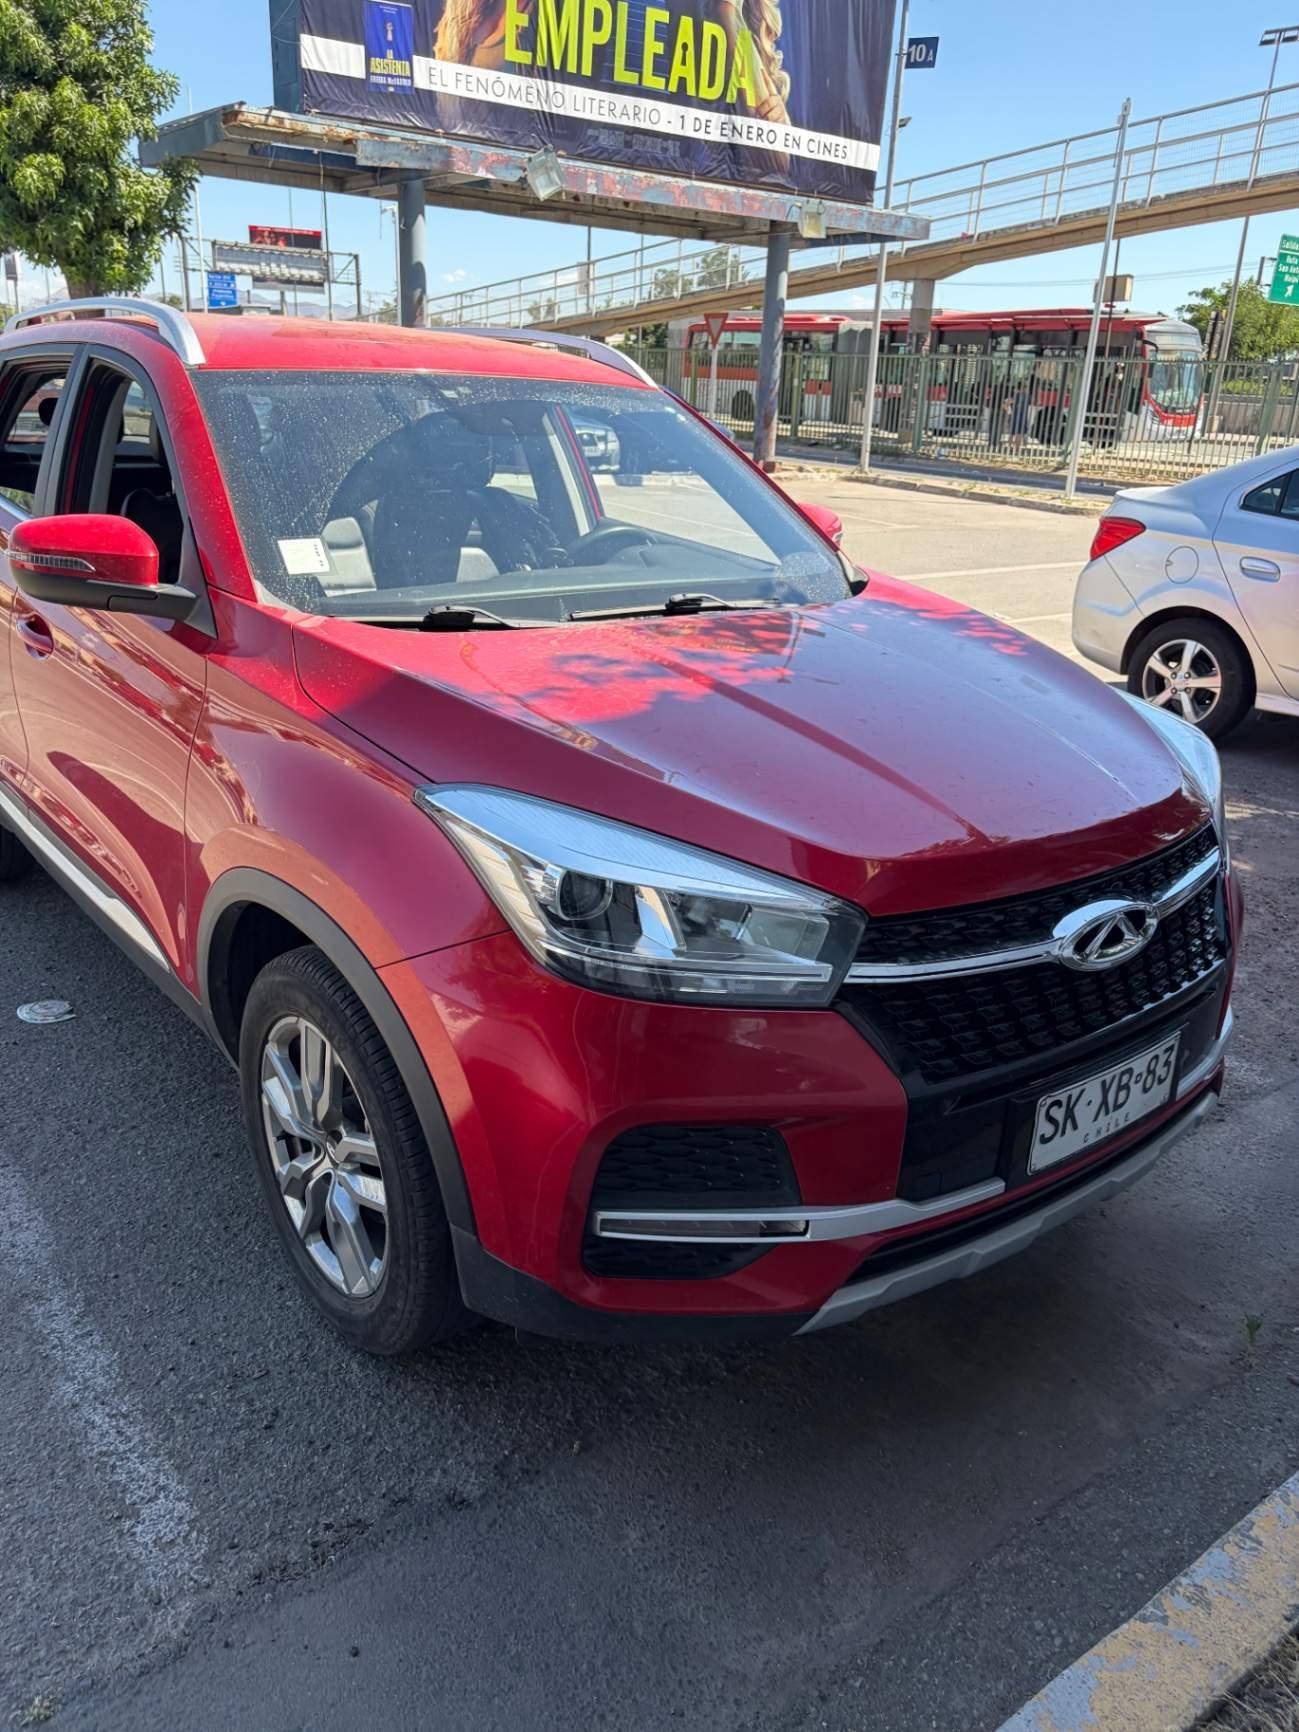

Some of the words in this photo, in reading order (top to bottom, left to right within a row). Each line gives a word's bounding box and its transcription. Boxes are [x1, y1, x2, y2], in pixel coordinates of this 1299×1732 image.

[504, 0, 756, 107] EMPLEADA
[428, 66, 448, 88] EL
[455, 72, 565, 109] FENÓMENO
[573, 94, 661, 125] LITERARIO
[679, 115, 685, 131] 1
[693, 117, 712, 135] DE
[720, 122, 777, 145] ENERO
[784, 133, 801, 150] EN
[807, 138, 848, 160] CINES
[1083, 1111, 1130, 1144] CHILE
